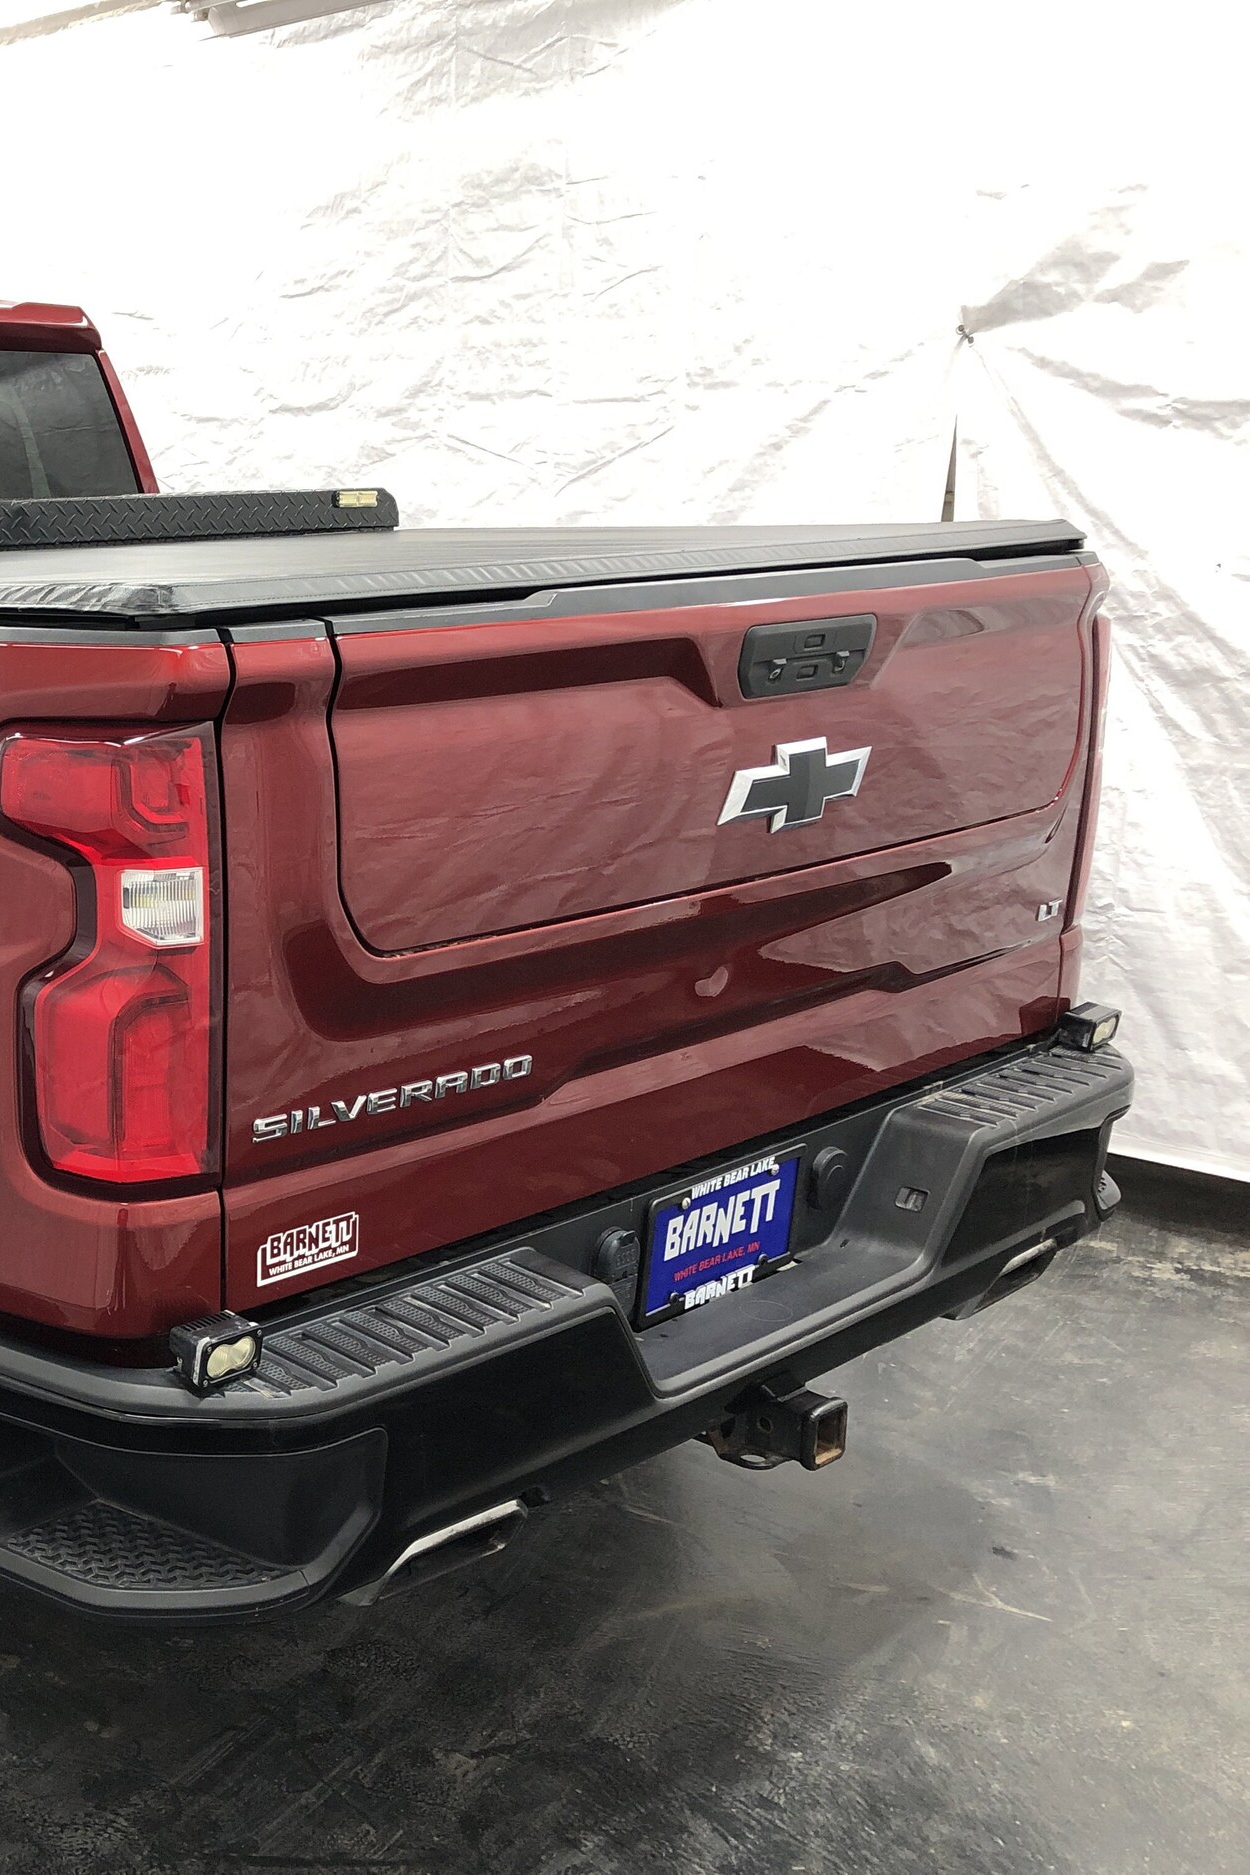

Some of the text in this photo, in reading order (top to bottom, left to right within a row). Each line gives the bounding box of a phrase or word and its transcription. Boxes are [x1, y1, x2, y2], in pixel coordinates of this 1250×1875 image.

[1037, 899, 1063, 922] LT
[252, 1054, 533, 1144] SILVERADO
[691, 1176, 723, 1200] WHITE
[723, 1167, 750, 1188] BEAR
[266, 1211, 356, 1266] BARNETT
[664, 1179, 781, 1262] BARNETT
[268, 1244, 350, 1277] WHITE BEAR LAKE, MN
[673, 1263, 699, 1282] WHITE
[698, 1254, 721, 1271] BEAR
[746, 1241, 761, 1254] MN
[683, 1264, 756, 1310] BARNETT
